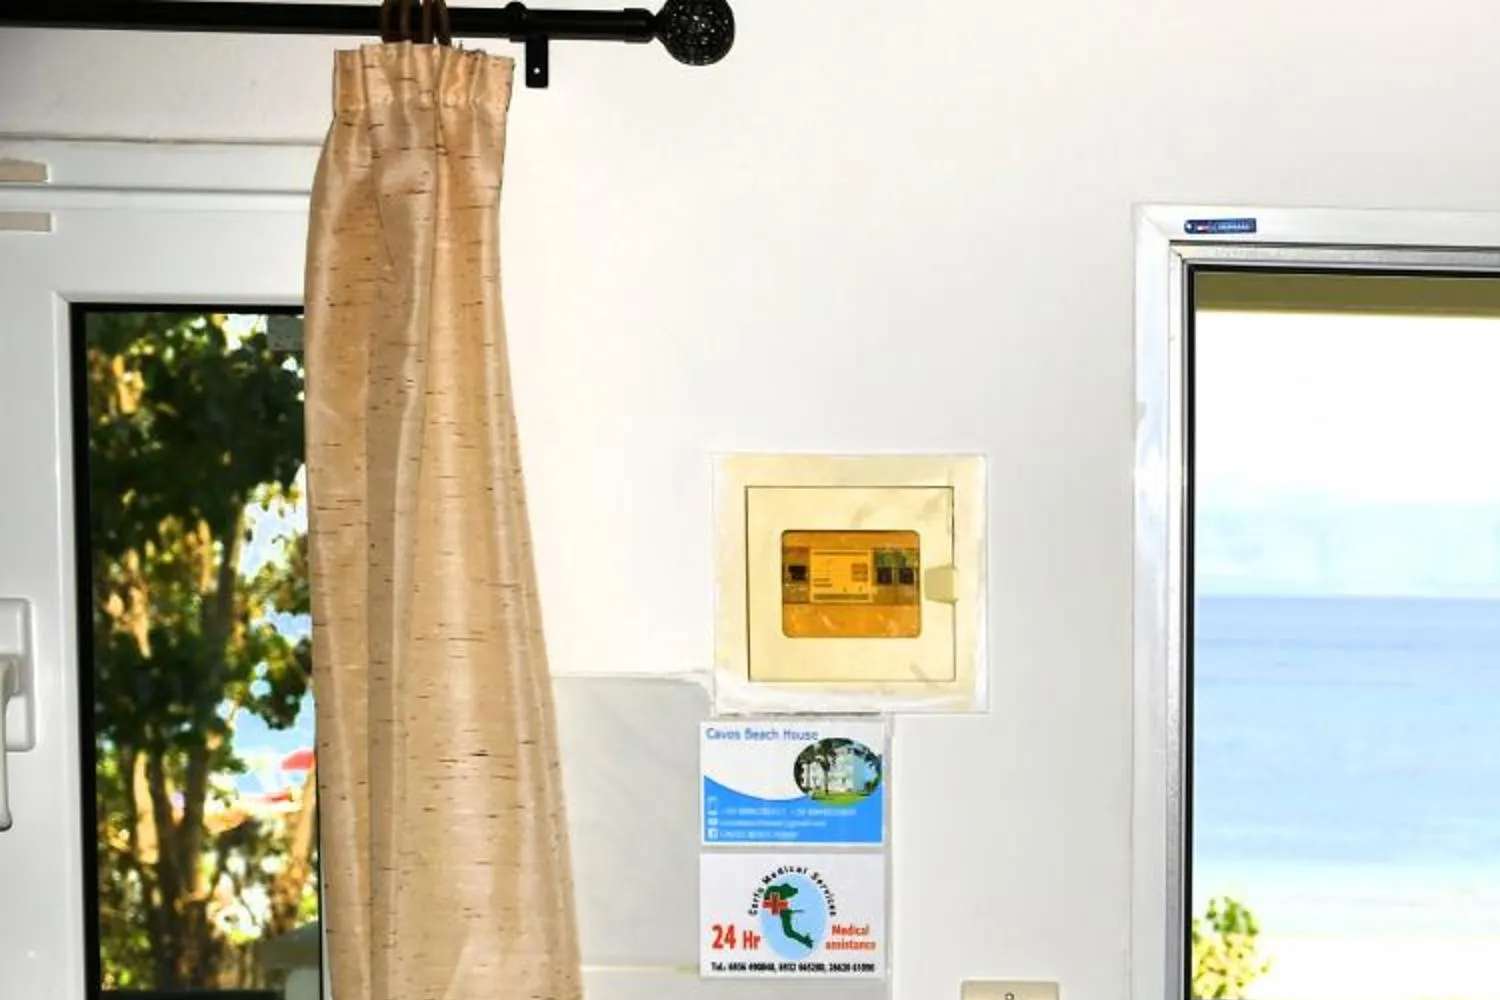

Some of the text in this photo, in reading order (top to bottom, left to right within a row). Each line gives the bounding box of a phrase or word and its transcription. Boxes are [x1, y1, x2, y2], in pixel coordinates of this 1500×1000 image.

[705, 727, 819, 741] Cavos Beach House
[761, 866, 809, 884] Medical
[811, 872, 837, 917] Services
[711, 924, 761, 950] 24 Hr
[825, 923, 877, 951] Medical assistance
